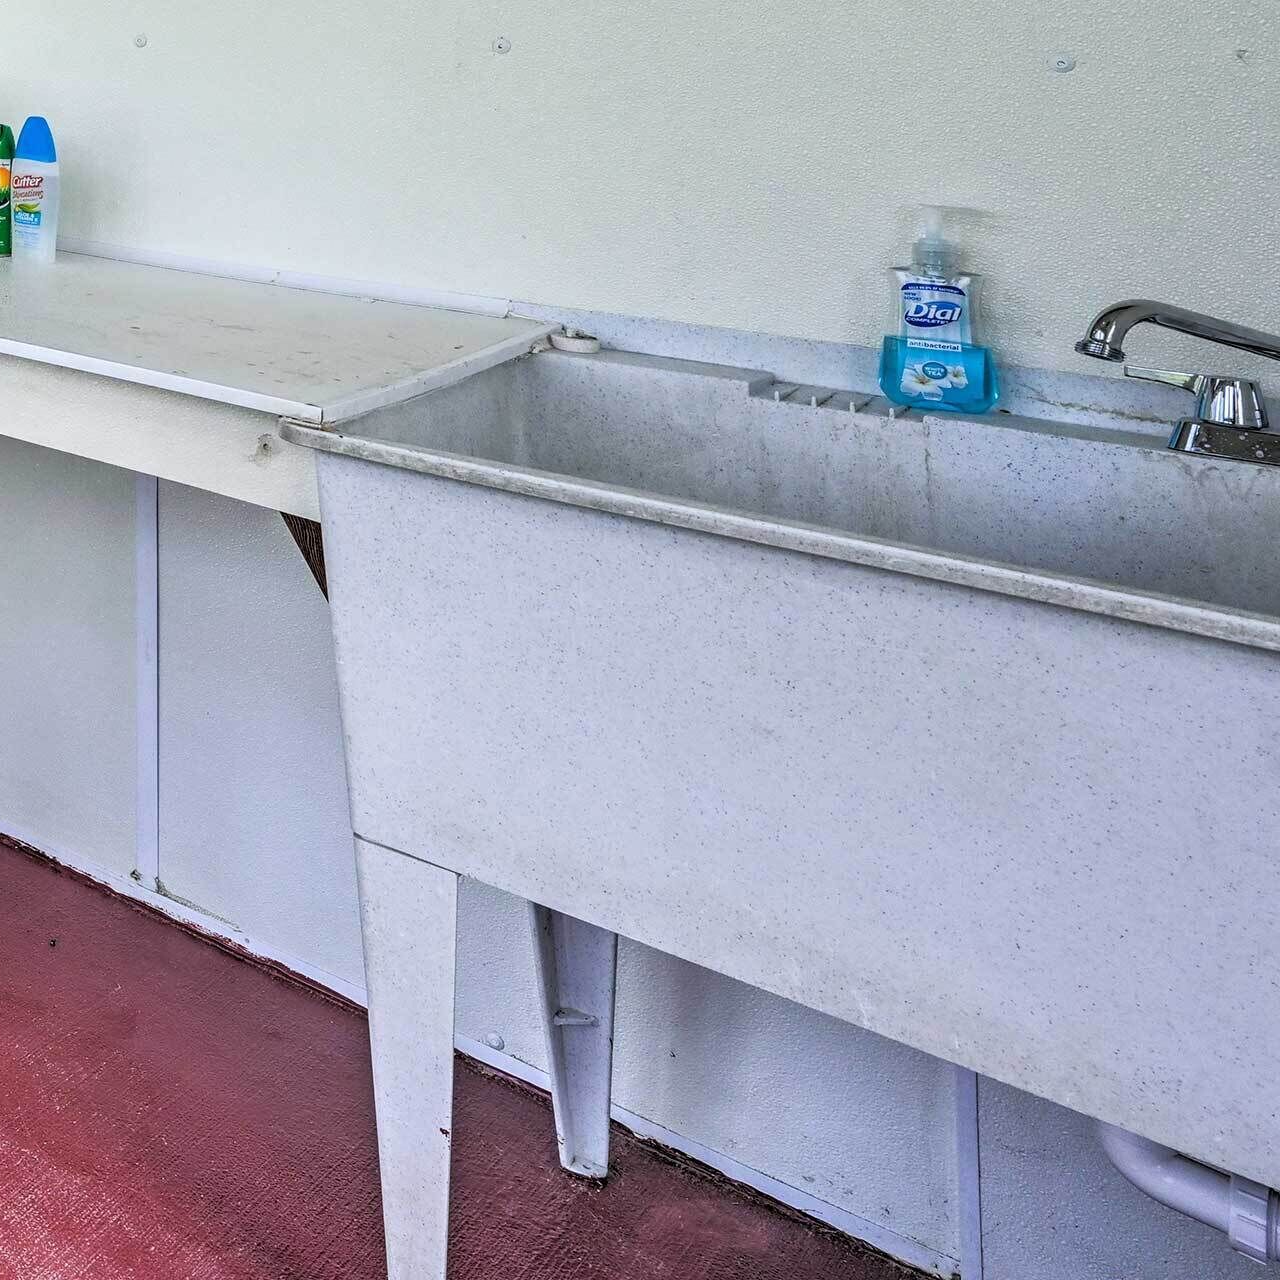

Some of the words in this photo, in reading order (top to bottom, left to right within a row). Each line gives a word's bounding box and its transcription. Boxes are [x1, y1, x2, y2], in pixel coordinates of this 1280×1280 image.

[12, 175, 43, 189] Cutter
[907, 303, 961, 321] Dial
[909, 341, 960, 351] antibacterial
